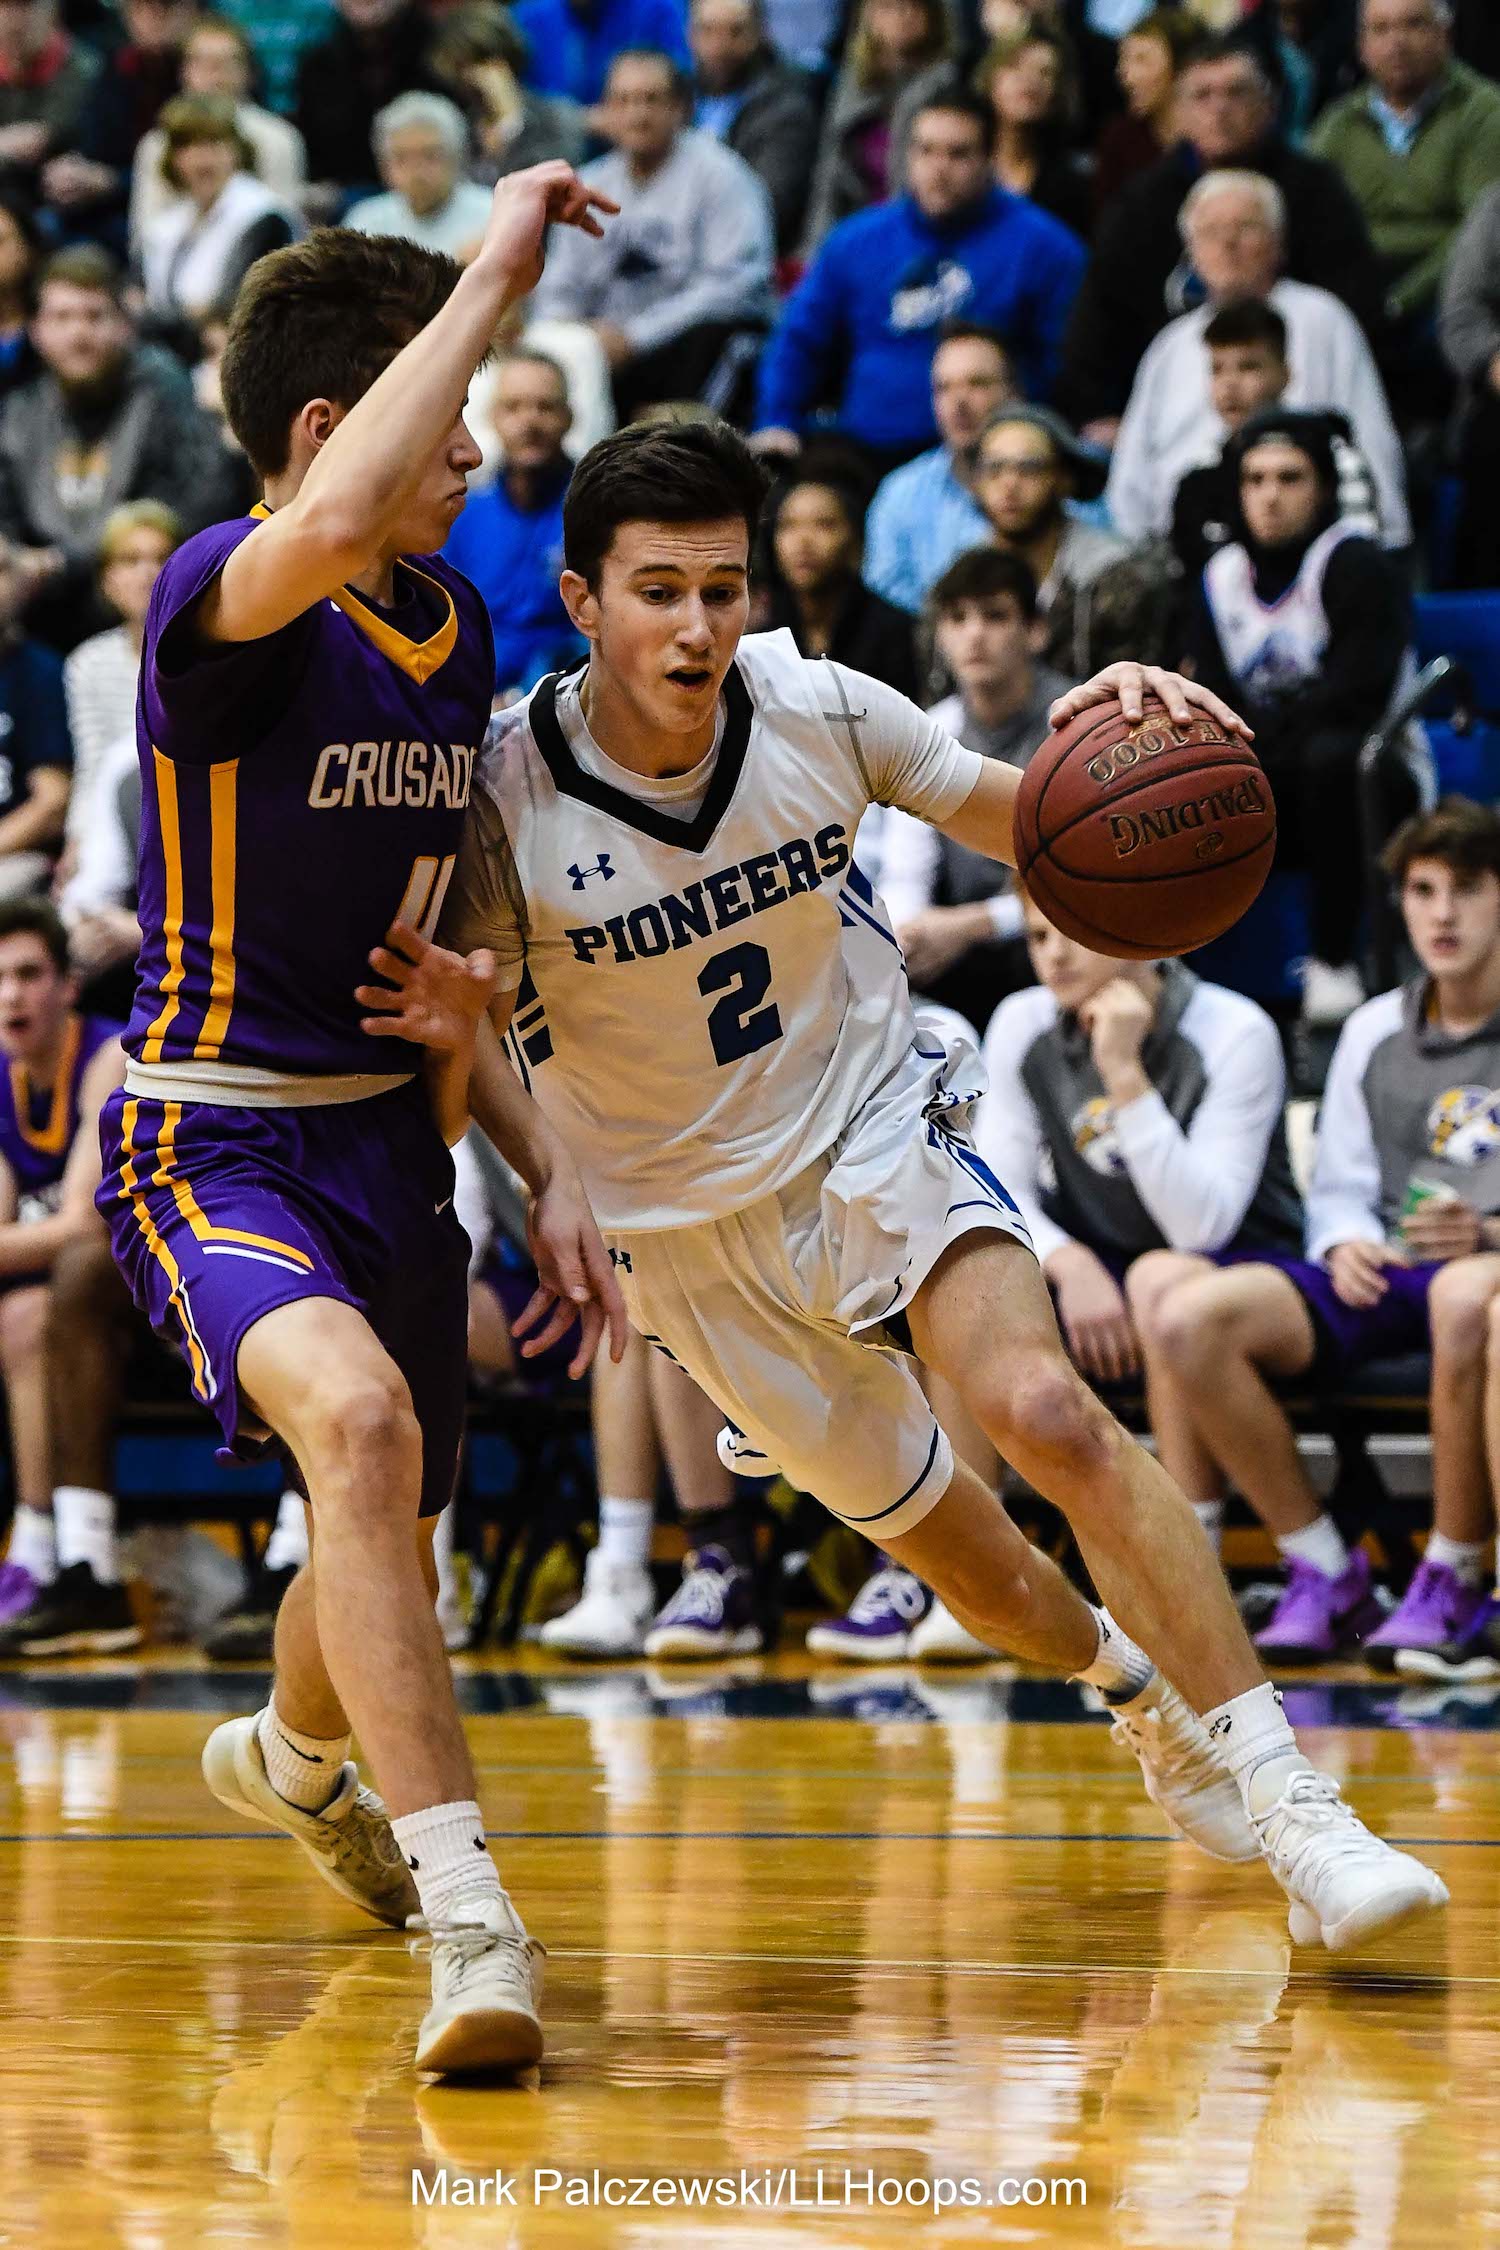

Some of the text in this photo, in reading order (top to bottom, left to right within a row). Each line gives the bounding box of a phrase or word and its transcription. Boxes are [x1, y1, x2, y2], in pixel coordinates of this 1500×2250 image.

[1109, 775, 1265, 858] SPALDING
[564, 823, 849, 965] PIONEERS
[697, 941, 784, 1067] 2
